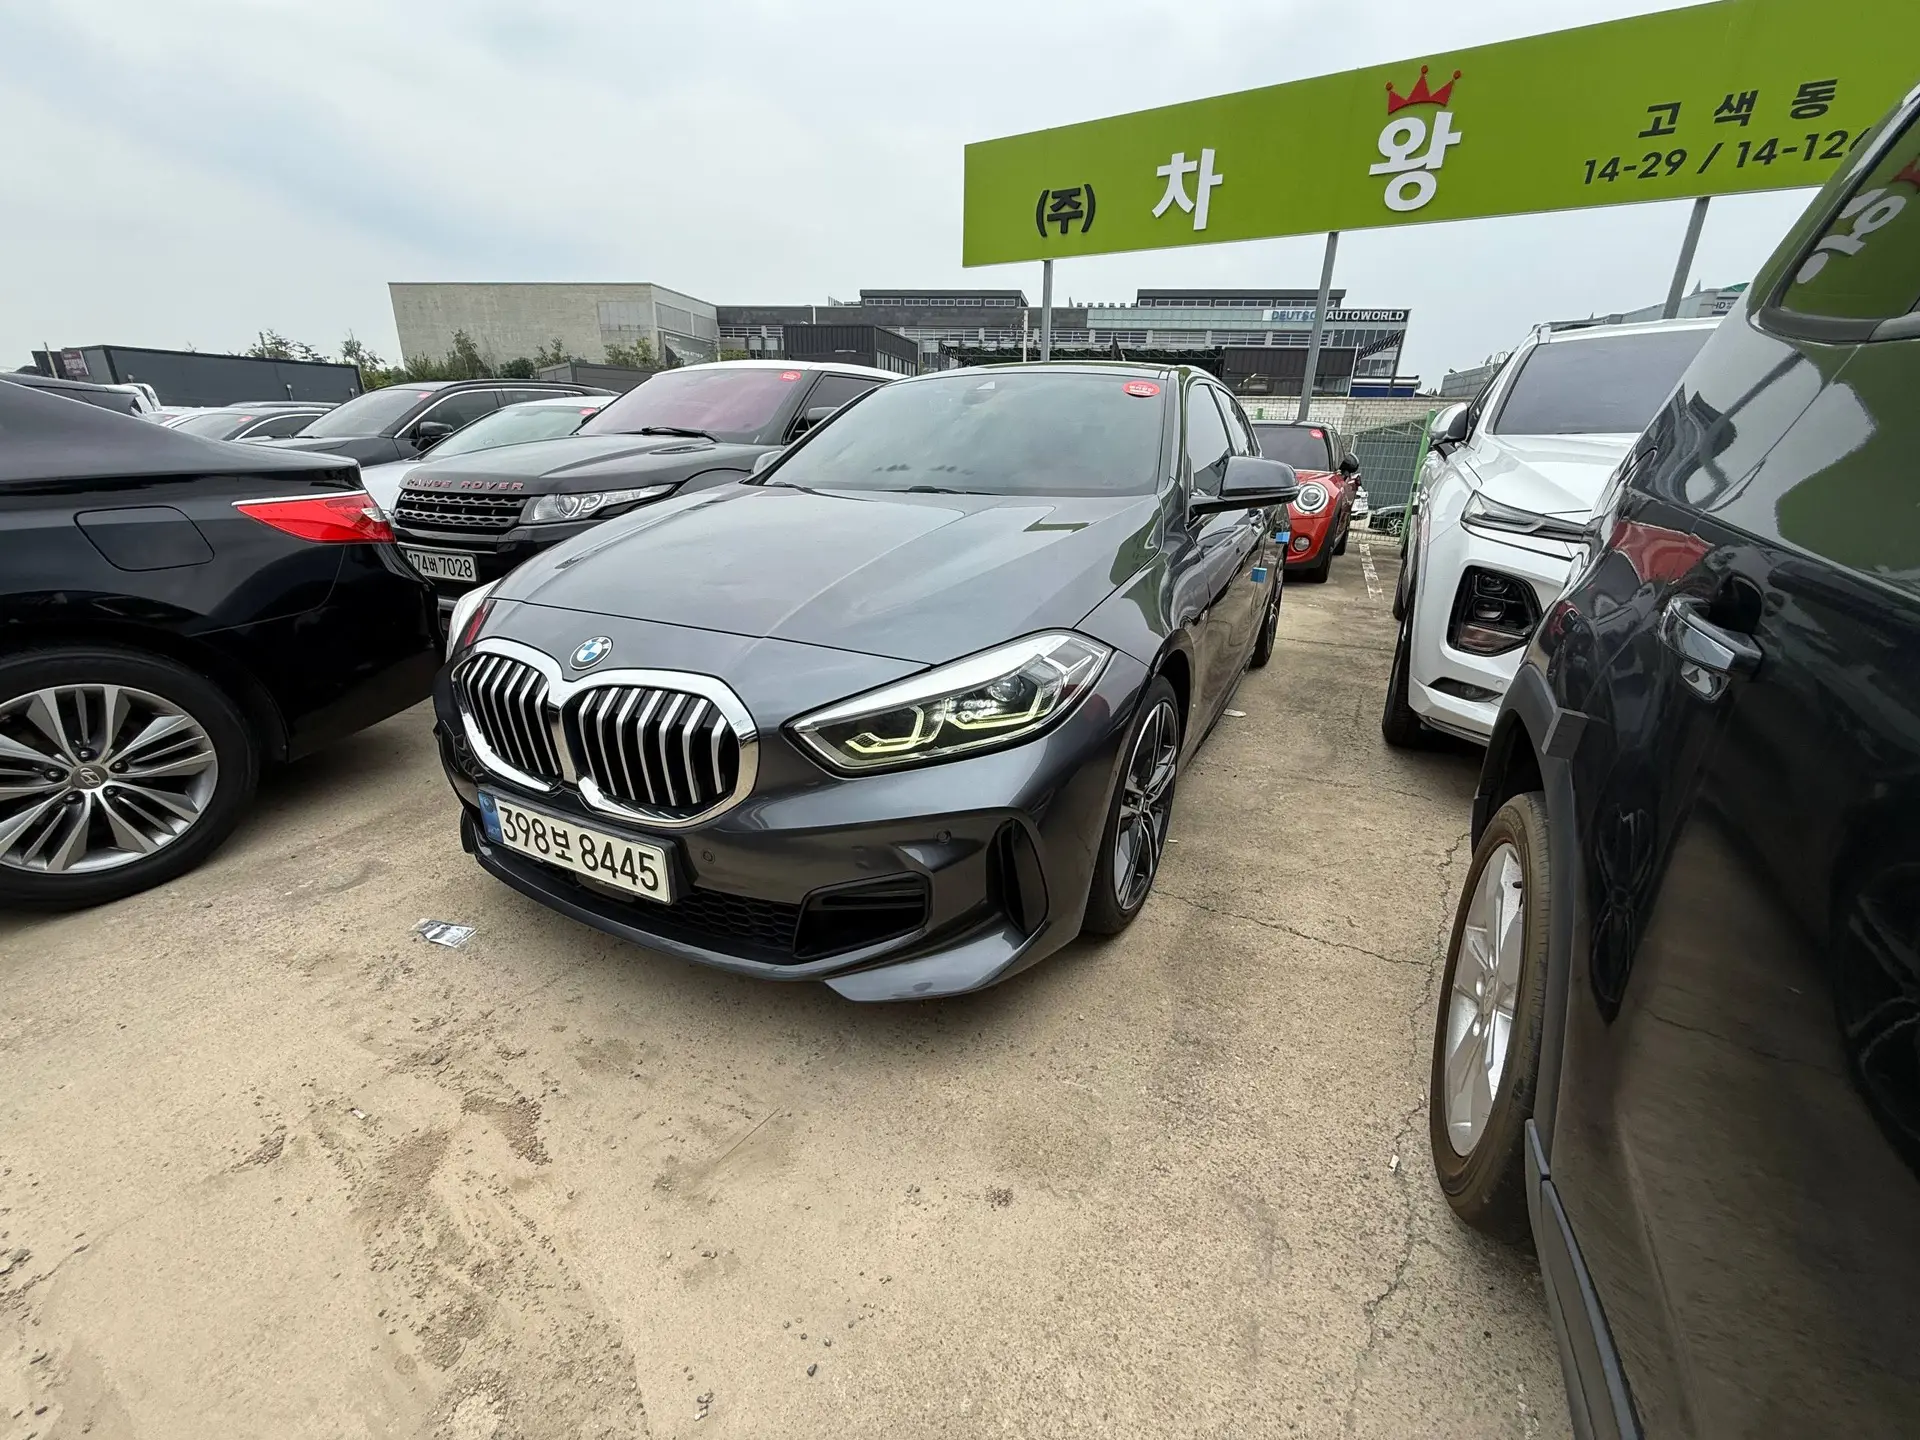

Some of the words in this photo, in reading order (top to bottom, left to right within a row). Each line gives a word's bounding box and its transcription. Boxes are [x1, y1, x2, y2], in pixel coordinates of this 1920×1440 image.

[1584, 149, 1687, 184] 14-29
[1036, 183, 1096, 238] (주)
[1326, 310, 1404, 321] AUTOWORLD
[460, 480, 524, 491] ROVER
[438, 556, 473, 578] 7028
[499, 805, 574, 863] 398보
[579, 833, 659, 891] 8445
